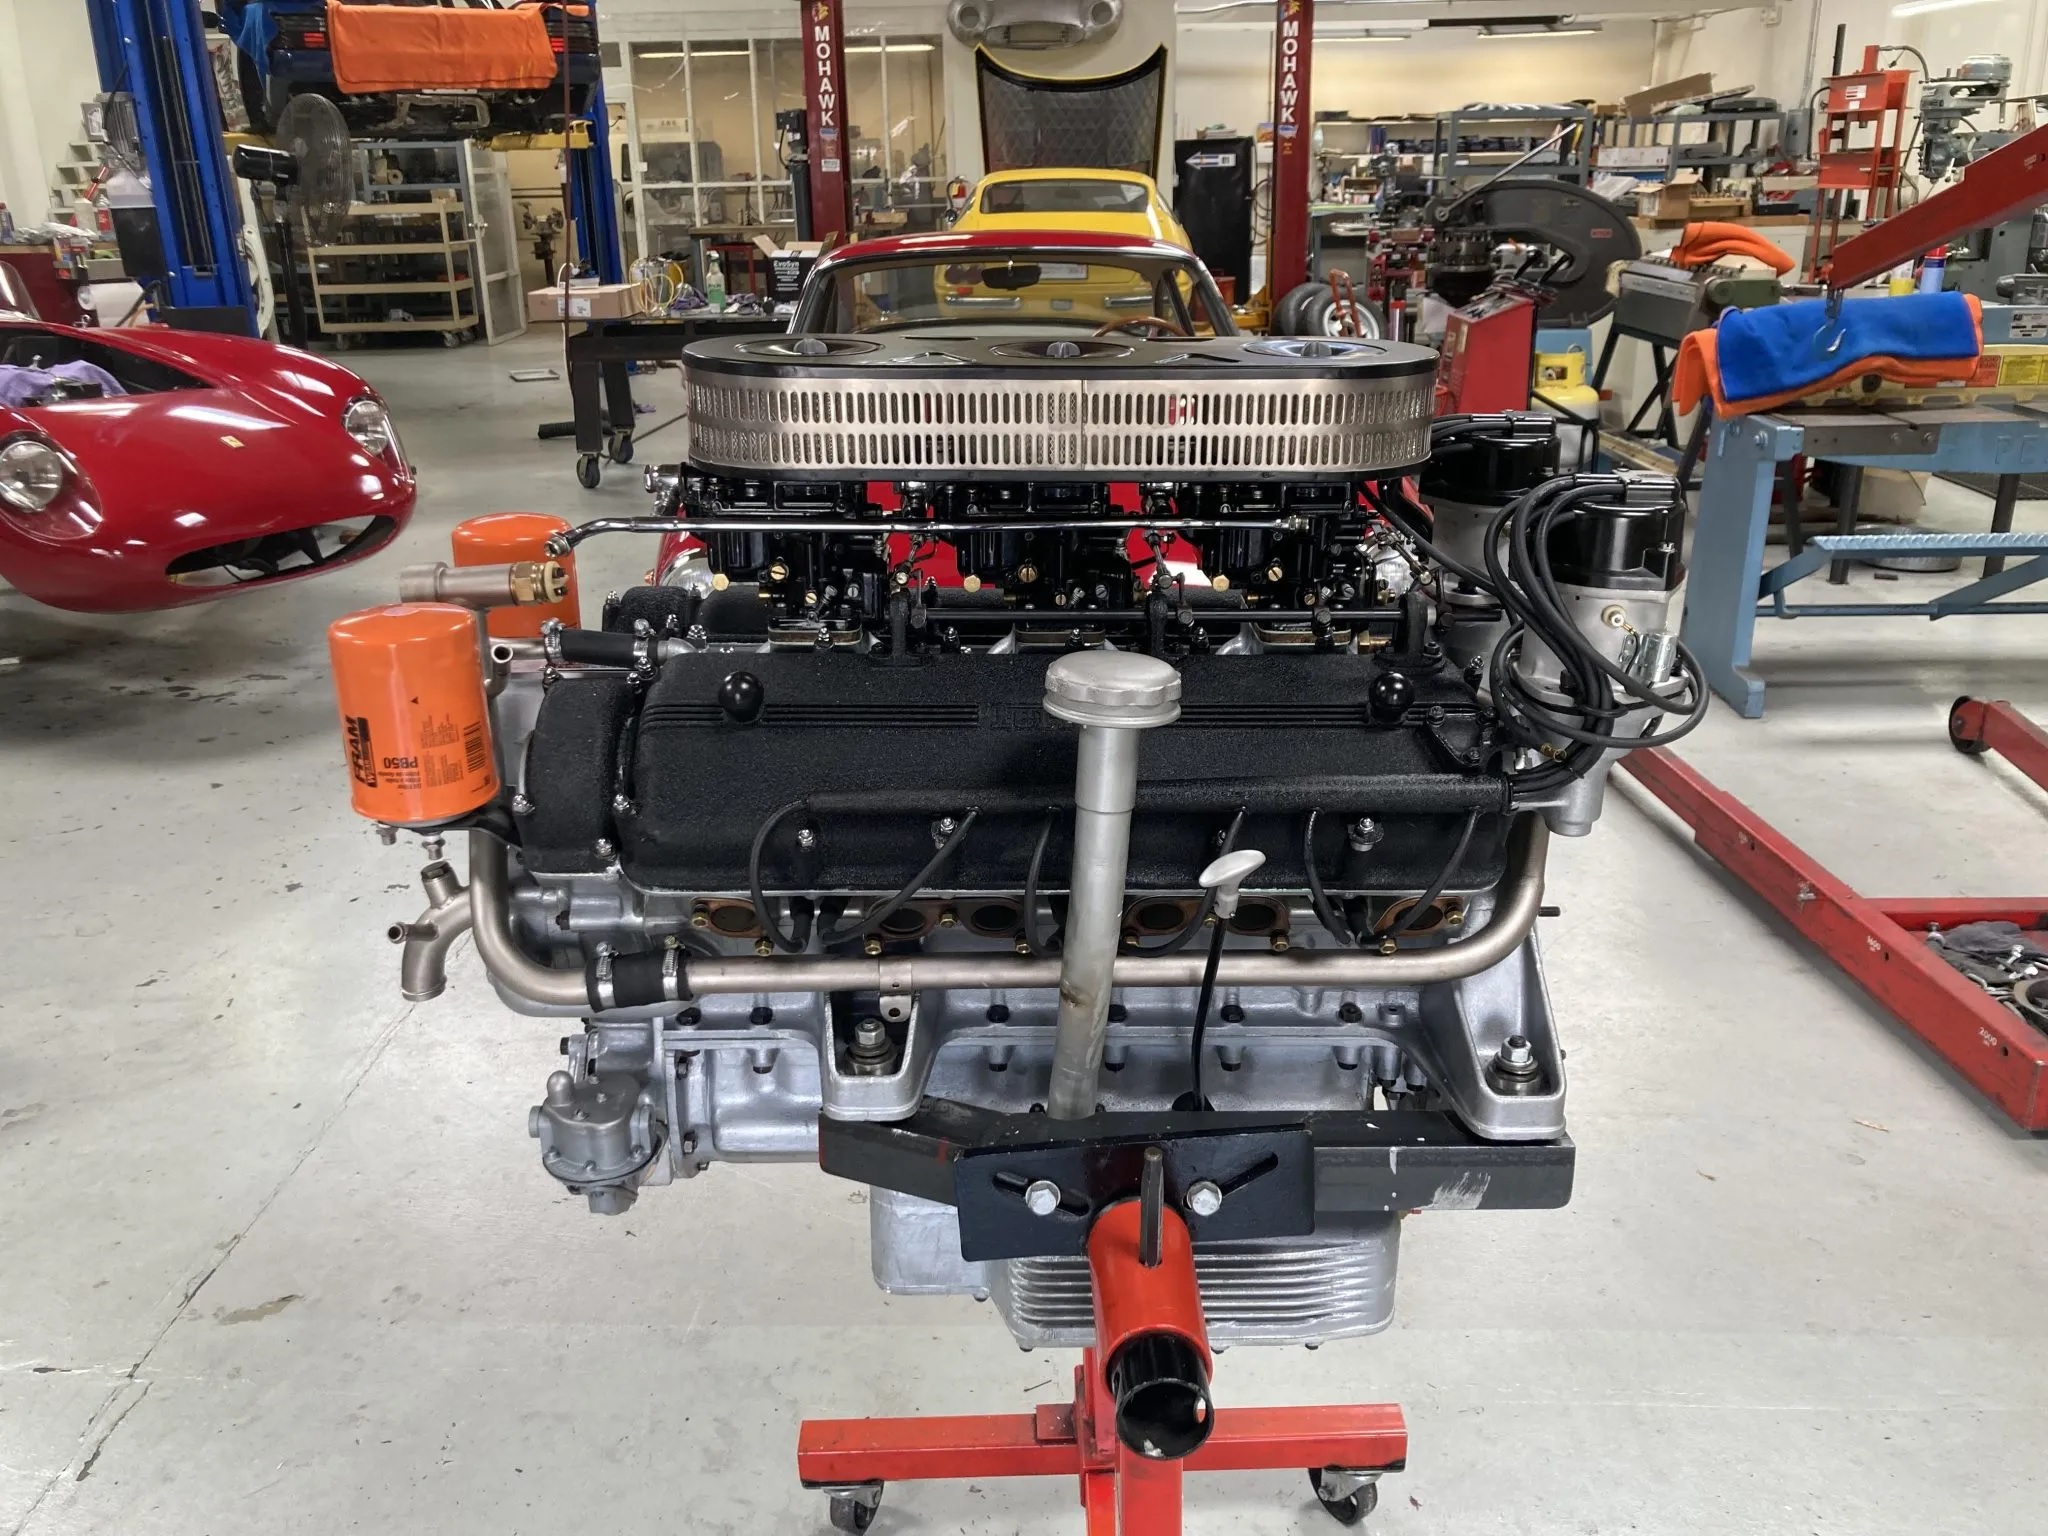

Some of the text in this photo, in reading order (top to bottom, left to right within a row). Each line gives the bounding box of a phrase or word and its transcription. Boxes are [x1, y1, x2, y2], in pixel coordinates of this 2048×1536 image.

[814, 25, 836, 126] MOHAWK
[1280, 20, 1299, 123] MOHAWK
[345, 715, 366, 784] FRAM
[383, 756, 418, 769] PB50
